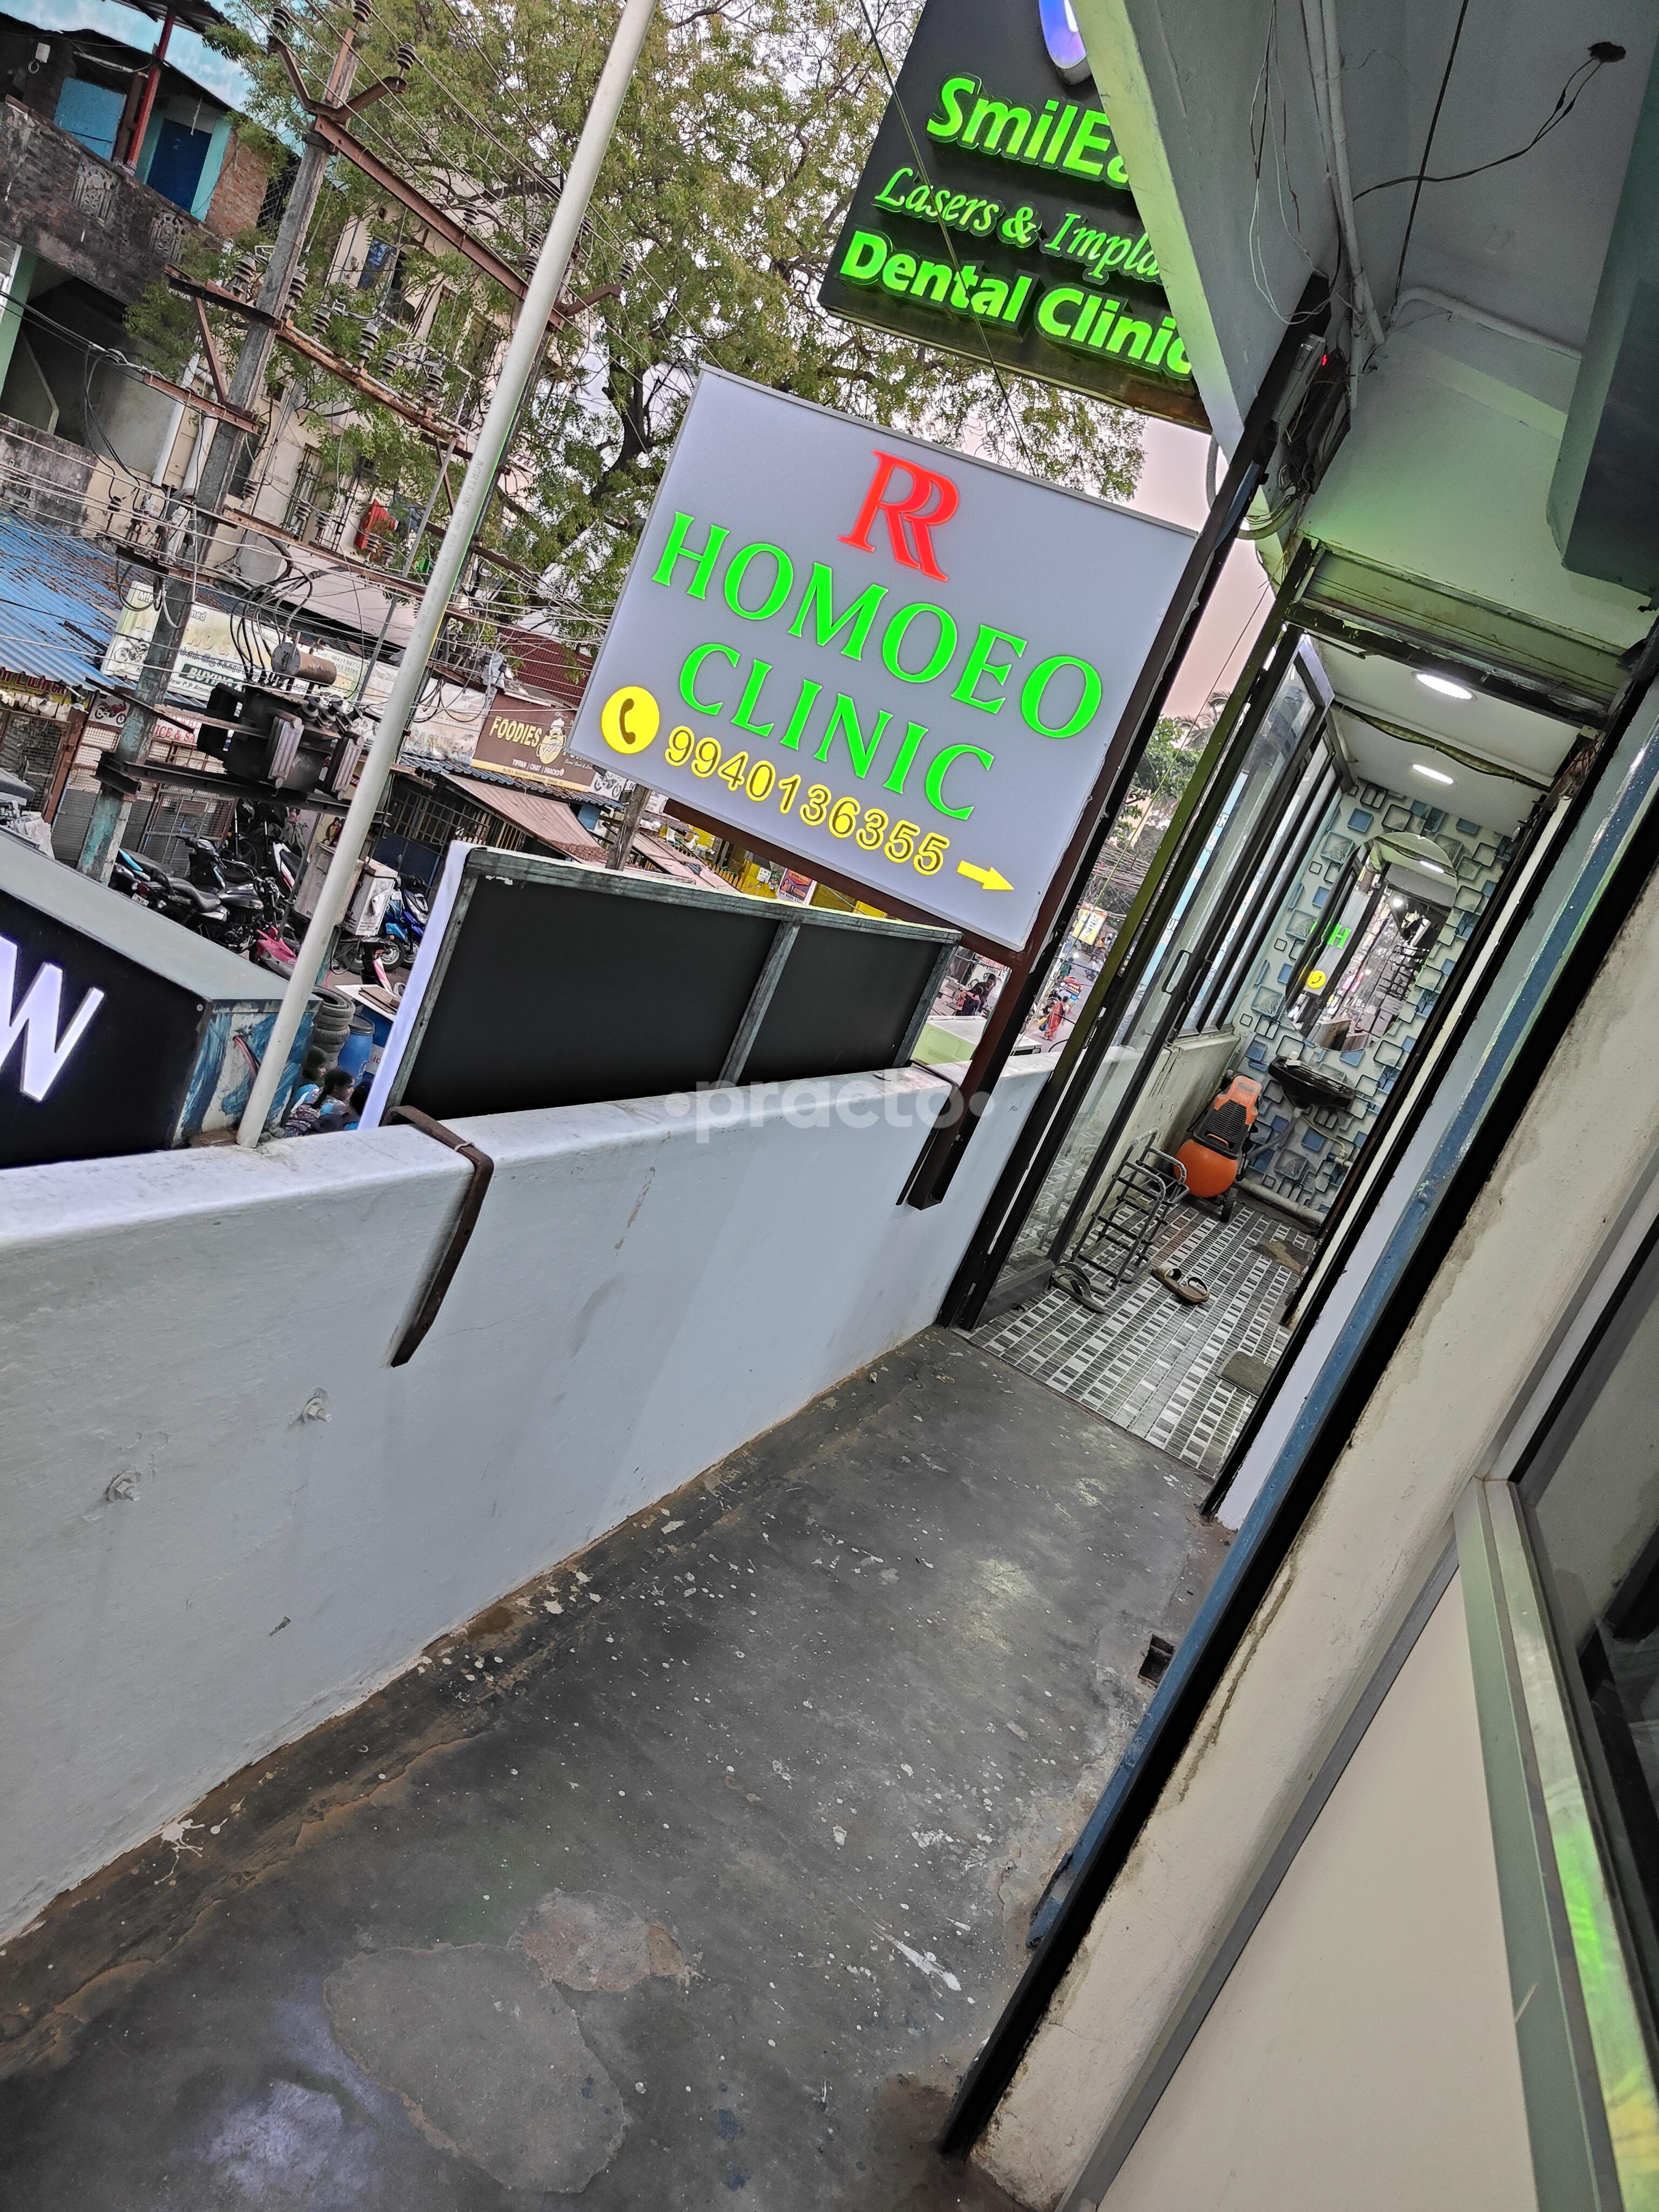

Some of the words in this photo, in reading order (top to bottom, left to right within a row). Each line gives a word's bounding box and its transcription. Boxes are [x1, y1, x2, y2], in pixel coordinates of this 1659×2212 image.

[875, 167, 999, 231] Lasers
[1002, 207, 1036, 244] &
[840, 231, 1033, 322] Dental
[652, 511, 1102, 739] HOMOEO
[488, 715, 543, 747] FOODIES
[679, 643, 994, 820] CLINIC
[665, 725, 949, 876] 9940136355
